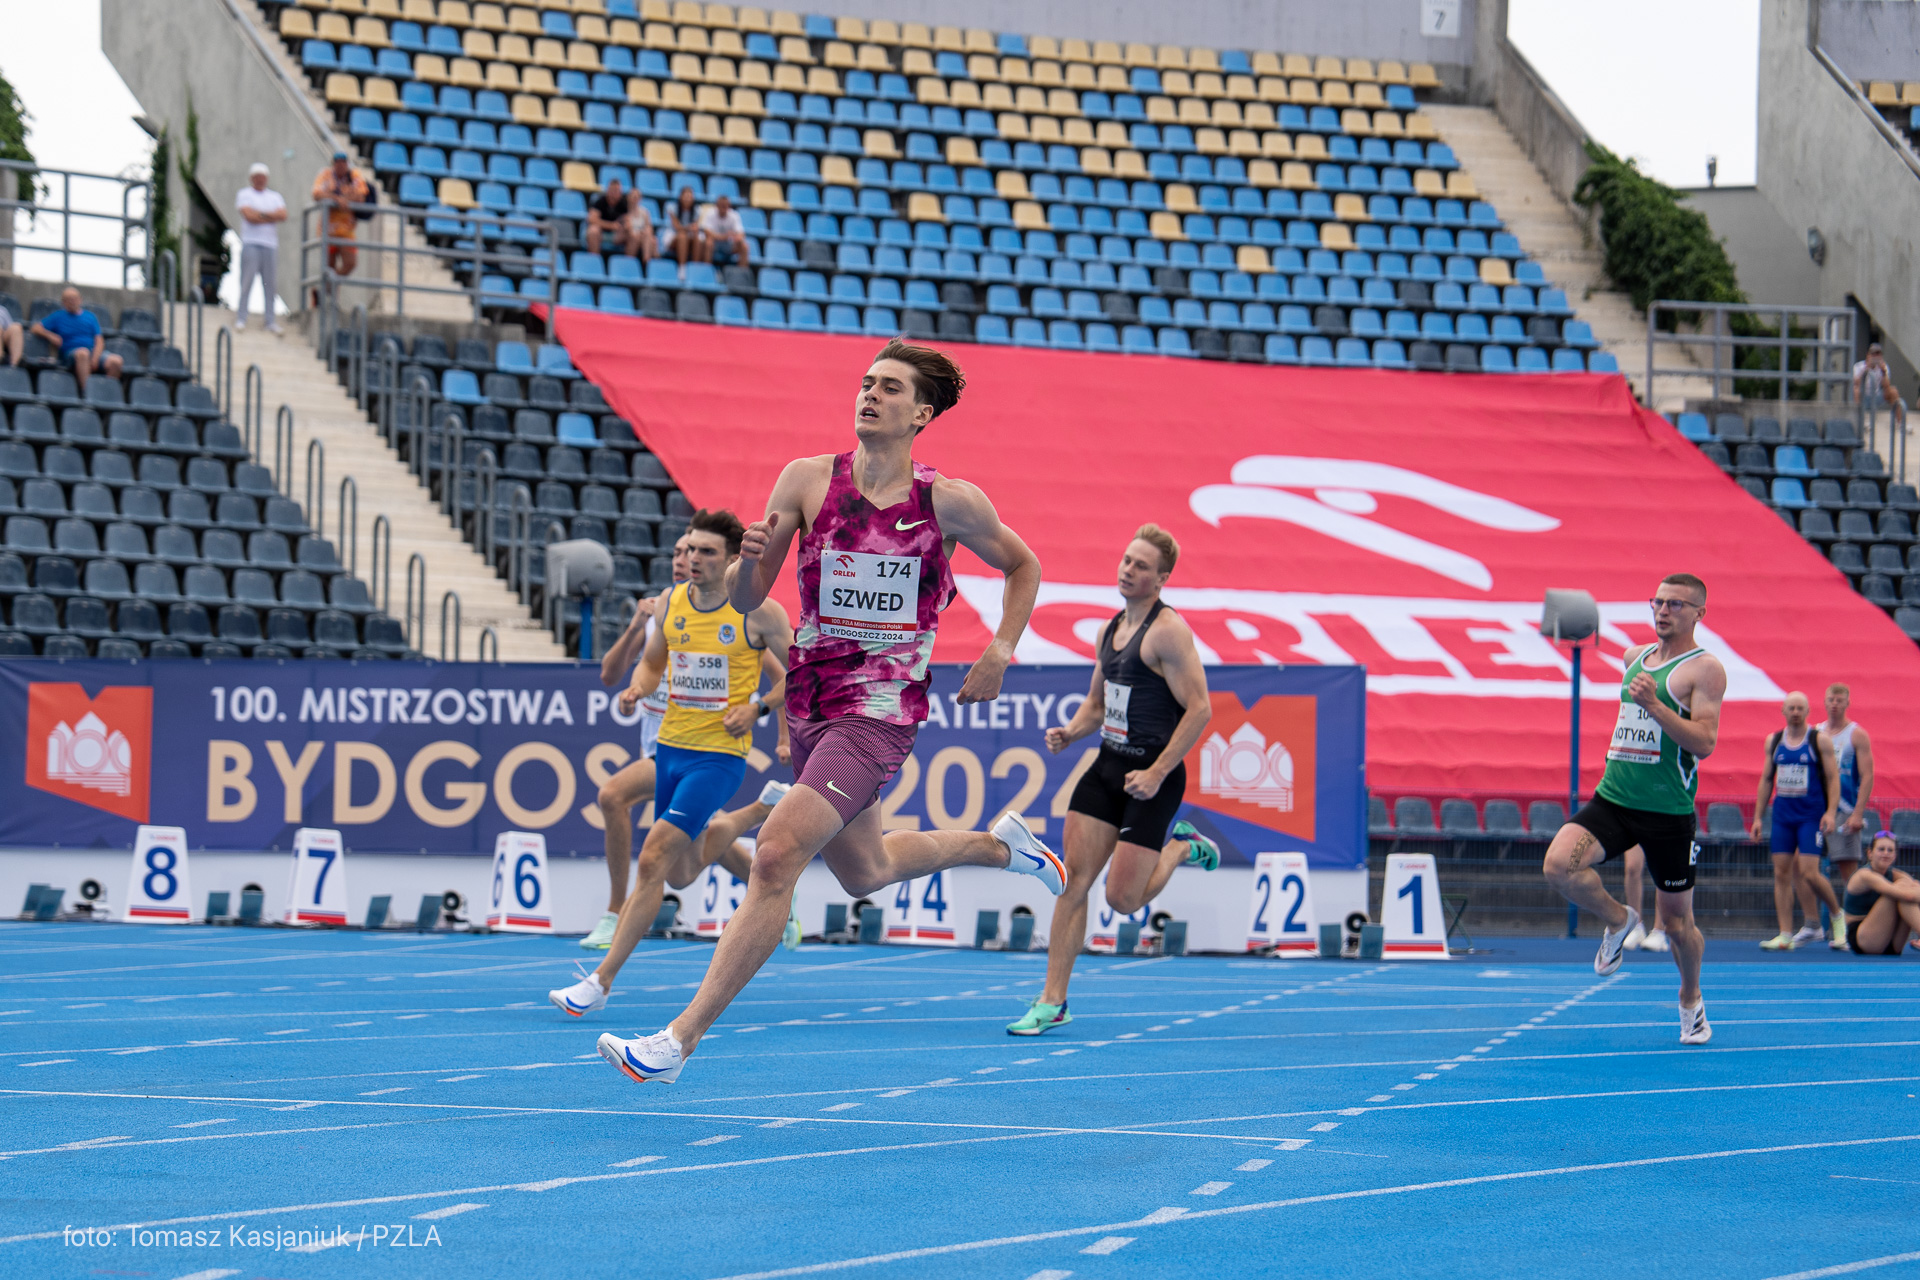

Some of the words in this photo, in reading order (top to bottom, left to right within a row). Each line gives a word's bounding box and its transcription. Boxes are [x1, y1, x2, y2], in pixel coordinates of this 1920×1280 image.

[1432, 9, 1447, 31] 7
[832, 569, 856, 578] ORLEN
[876, 560, 912, 579] 174
[831, 587, 904, 612] SZWED
[830, 627, 880, 640] BYDGOSZCZ
[882, 633, 903, 641] 2024
[854, 620, 886, 629] Mistrzostwa
[698, 657, 722, 669] 558
[672, 674, 726, 691] KAROLEWSKI
[211, 686, 287, 723] 100.
[298, 687, 574, 726] MISTRZOSTWA
[1636, 708, 1654, 721] 10
[143, 846, 179, 901] 8
[307, 848, 337, 905] 7
[514, 853, 542, 909] 6
[922, 870, 947, 922] 4
[1253, 873, 1271, 932] 2
[1281, 874, 1307, 932] 2
[1398, 874, 1424, 934] 1
